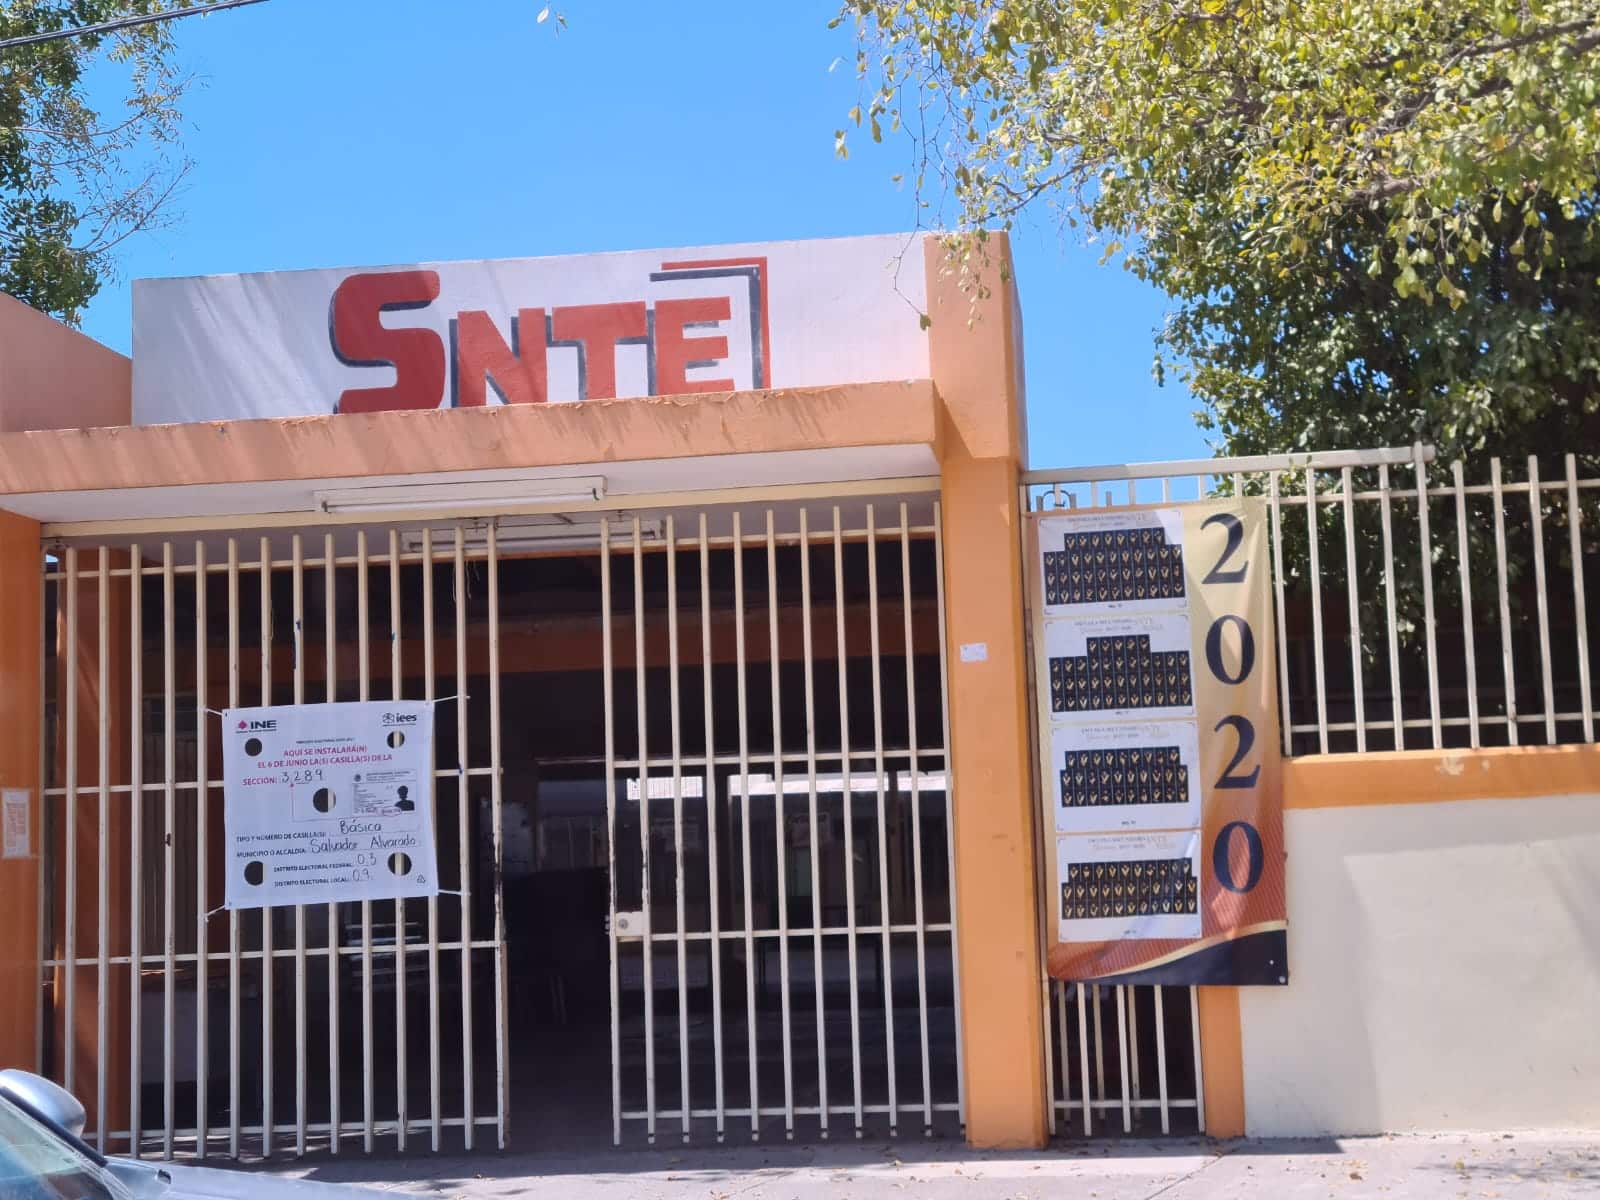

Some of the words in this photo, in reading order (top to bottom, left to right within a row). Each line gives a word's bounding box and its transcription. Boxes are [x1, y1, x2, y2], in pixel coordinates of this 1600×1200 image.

[329, 270, 735, 414] SNTE
[250, 719, 277, 730] INE
[396, 712, 417, 723] iees
[303, 748, 313, 756] SE
[257, 761, 266, 769] EL
[285, 758, 308, 767] JUNIO
[383, 753, 393, 761] LA
[339, 818, 382, 834] Básica
[370, 833, 416, 849] Alvarado
